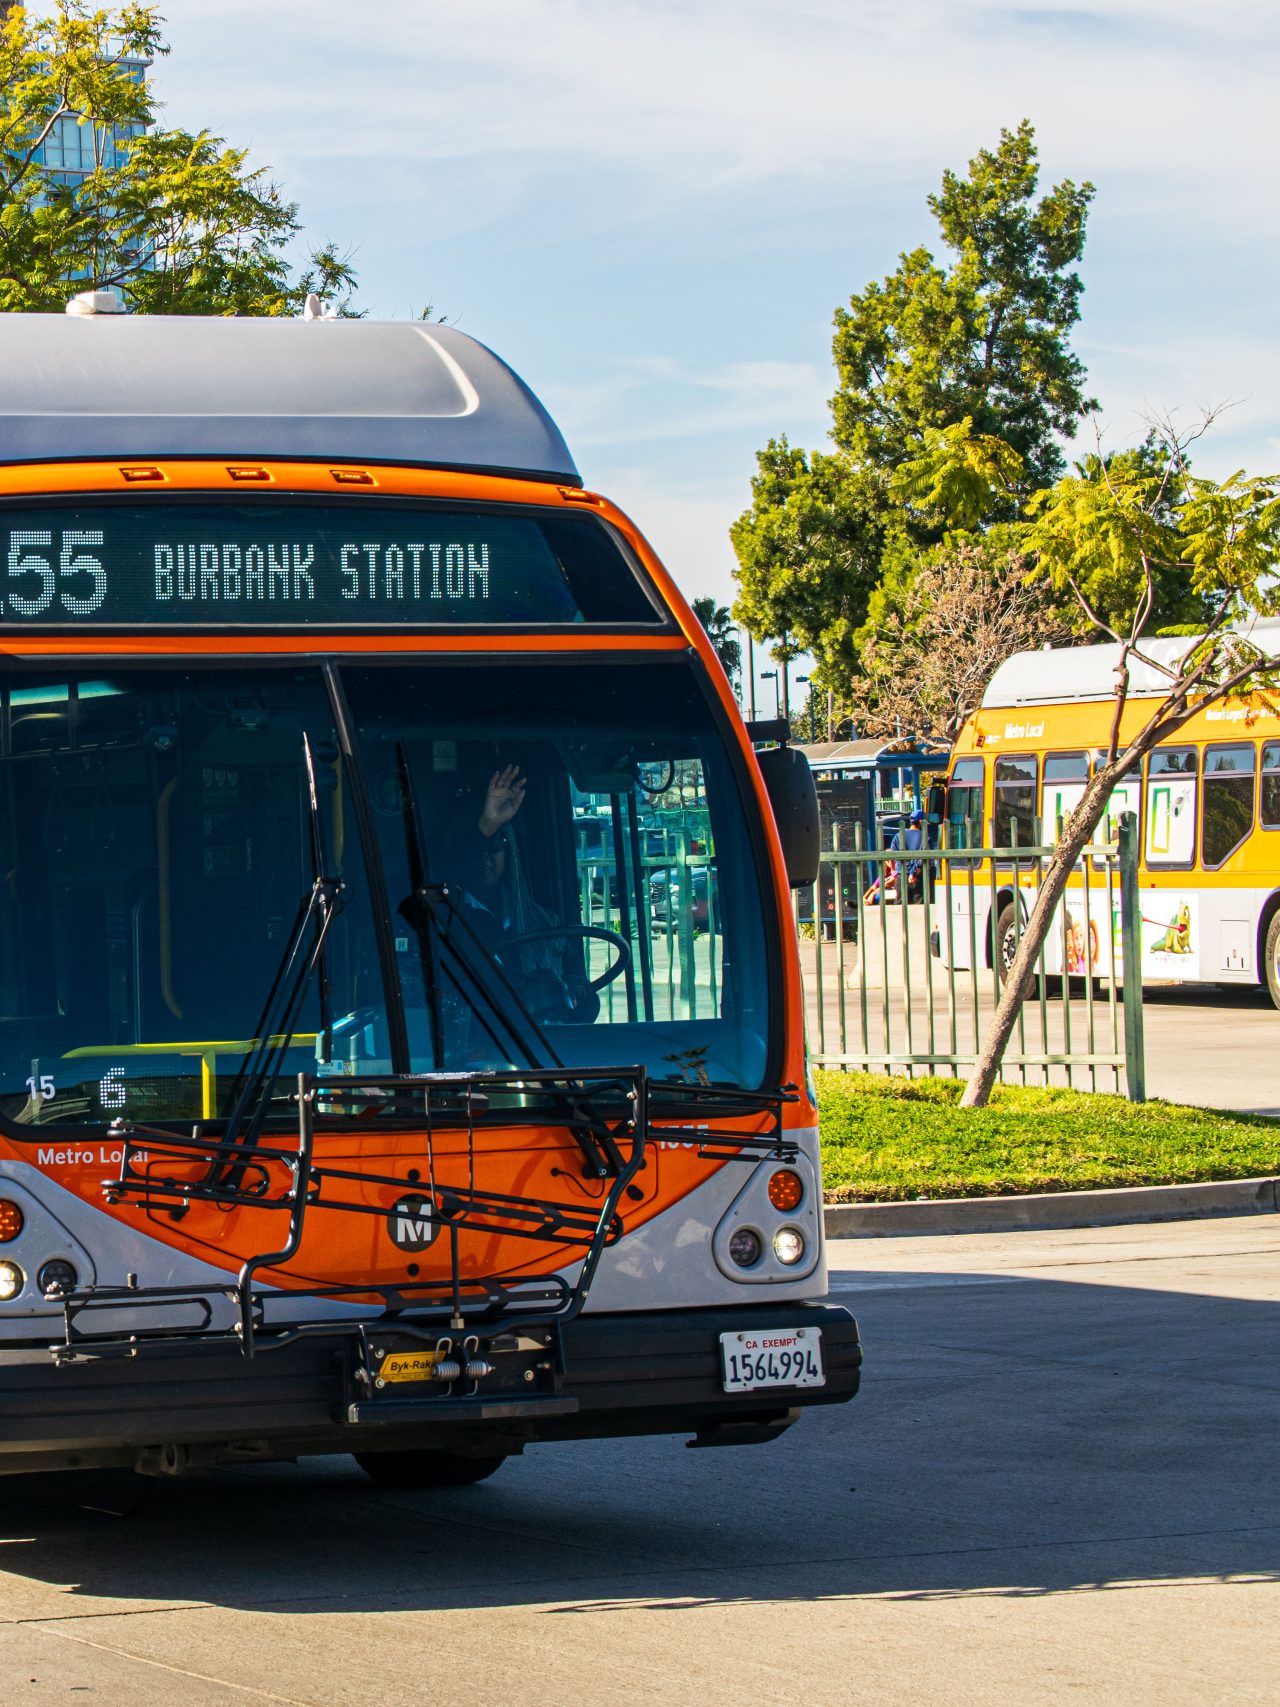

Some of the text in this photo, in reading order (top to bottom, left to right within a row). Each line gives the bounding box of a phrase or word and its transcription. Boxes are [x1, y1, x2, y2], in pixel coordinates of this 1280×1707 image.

[154, 544, 315, 600] BURBANK
[341, 544, 489, 599] STATION
[1005, 720, 1045, 739] Metro Local
[26, 1075, 56, 1100] 15
[99, 1067, 126, 1108] 6
[37, 1147, 148, 1165] Metro Loal
[397, 1203, 432, 1242] M
[745, 1337, 798, 1350] CA EXEMPT
[729, 1350, 818, 1383] 1564994
